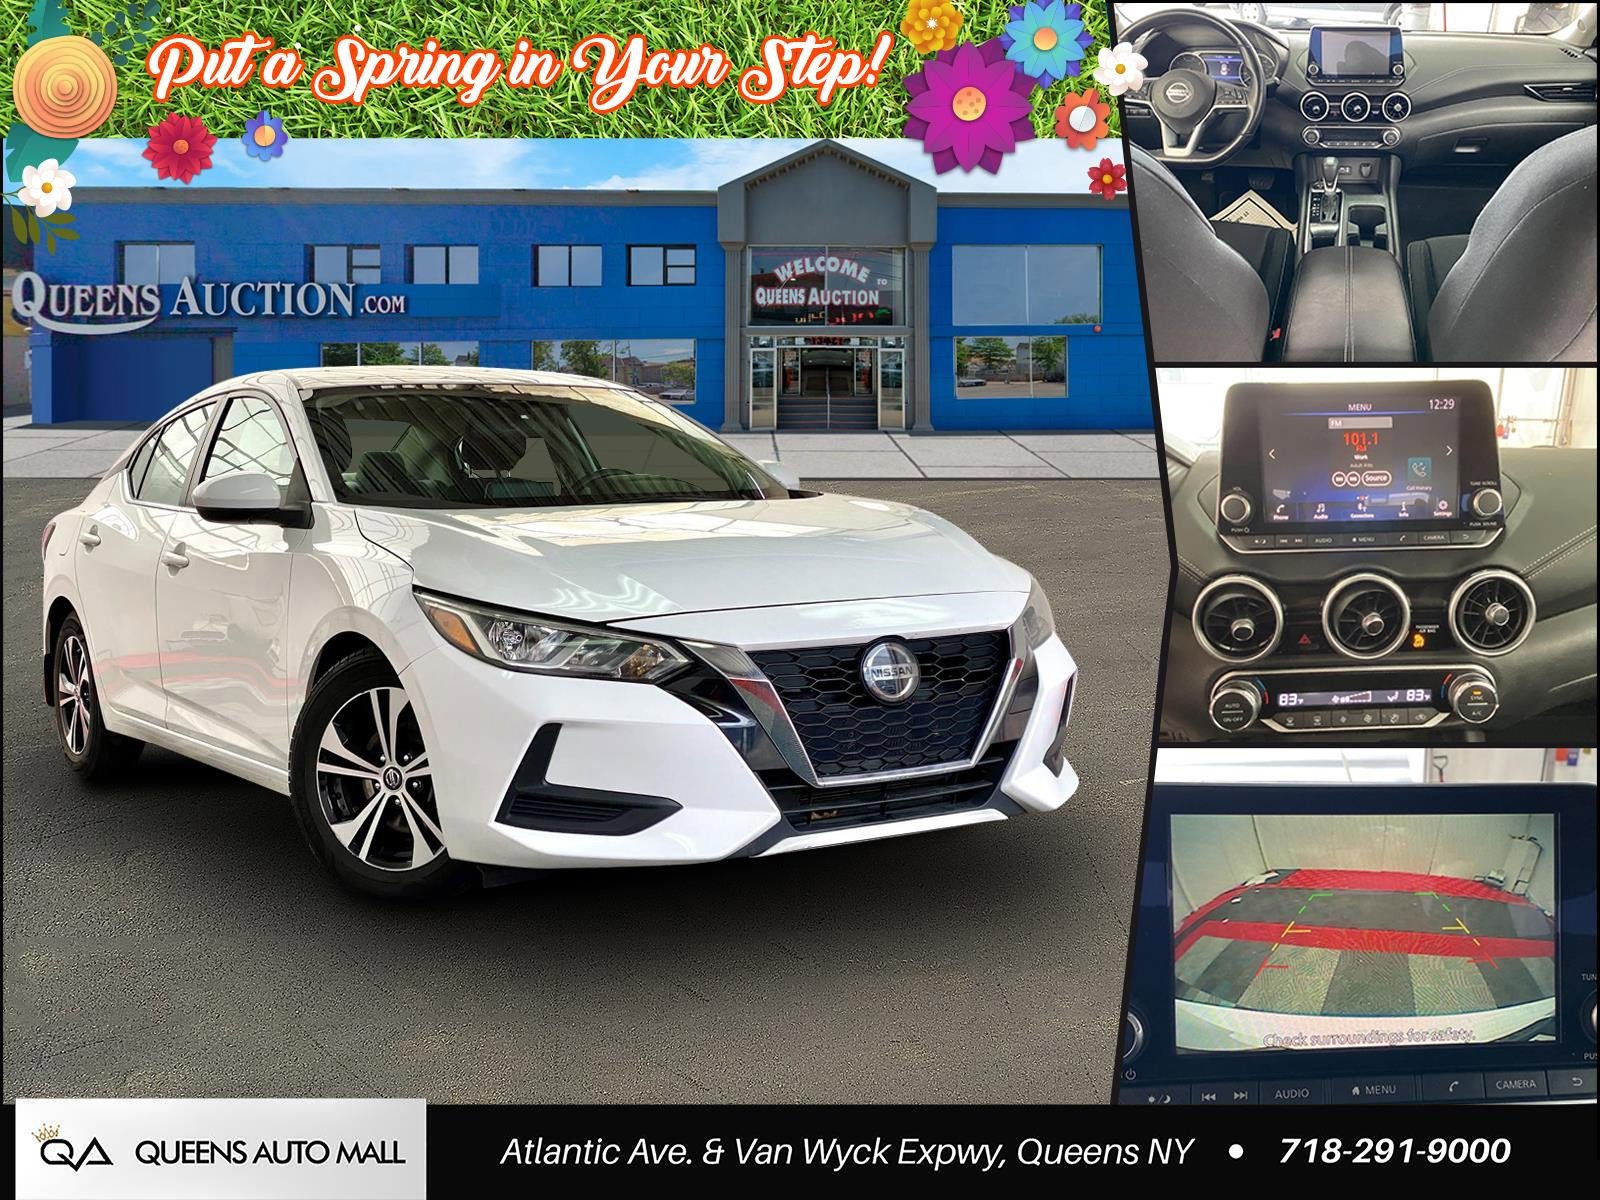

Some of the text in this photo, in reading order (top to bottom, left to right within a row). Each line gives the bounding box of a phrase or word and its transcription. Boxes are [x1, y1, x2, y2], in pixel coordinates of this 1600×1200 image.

[773, 255, 871, 284] WELCOME
[877, 277, 888, 286] TO
[755, 286, 879, 306] QUEENS AUCTION
[11, 271, 161, 334] QUEENS
[1348, 403, 1372, 412] MENU
[1429, 399, 1455, 410] 12:29
[1343, 431, 1379, 446] 101.1
[870, 665, 913, 679] NISSAN
[1263, 1026, 1476, 1047] Check surroundings for safety.
[1365, 1085, 1396, 1095] MENU
[1495, 1079, 1537, 1090] CAMERA
[1274, 1088, 1310, 1099] AUDIO
